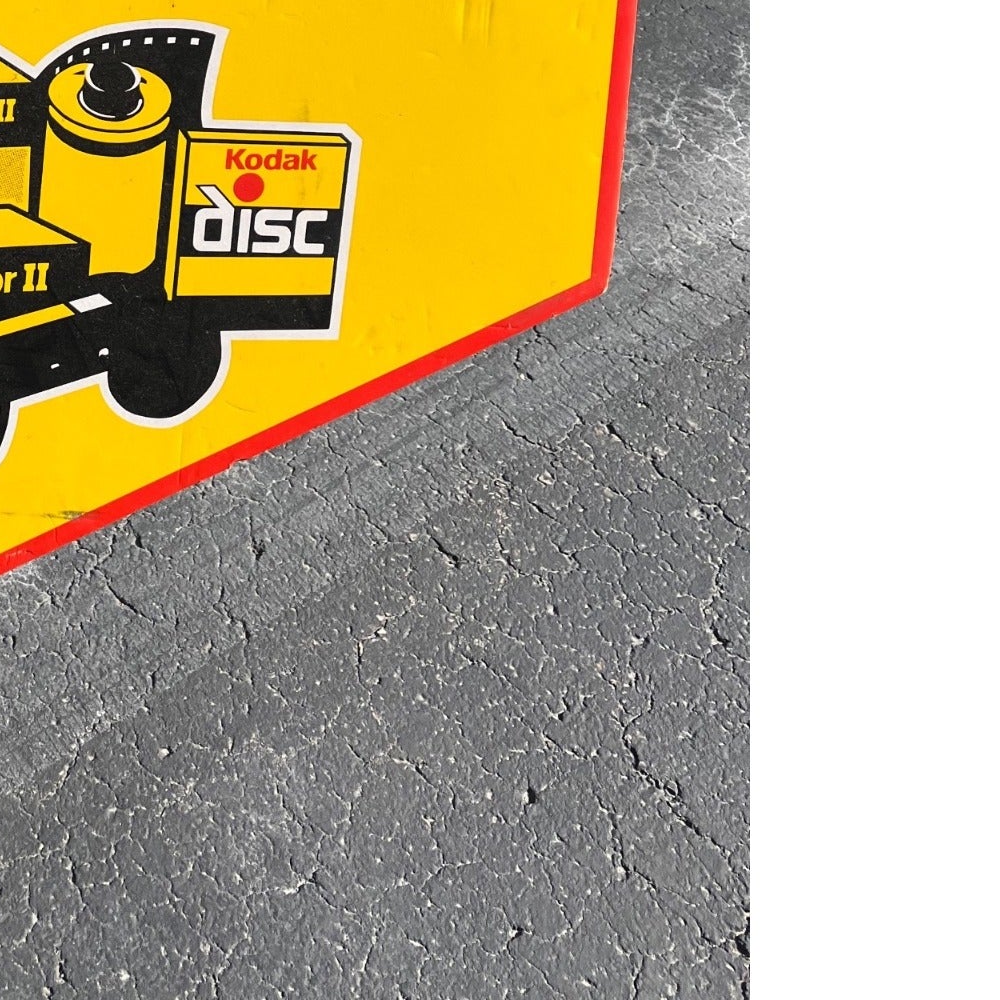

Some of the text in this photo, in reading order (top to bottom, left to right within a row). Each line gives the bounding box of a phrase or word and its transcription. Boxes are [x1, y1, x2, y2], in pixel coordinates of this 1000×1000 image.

[225, 148, 318, 171] Kodak
[192, 184, 329, 255] disc
[22, 262, 50, 292] II
